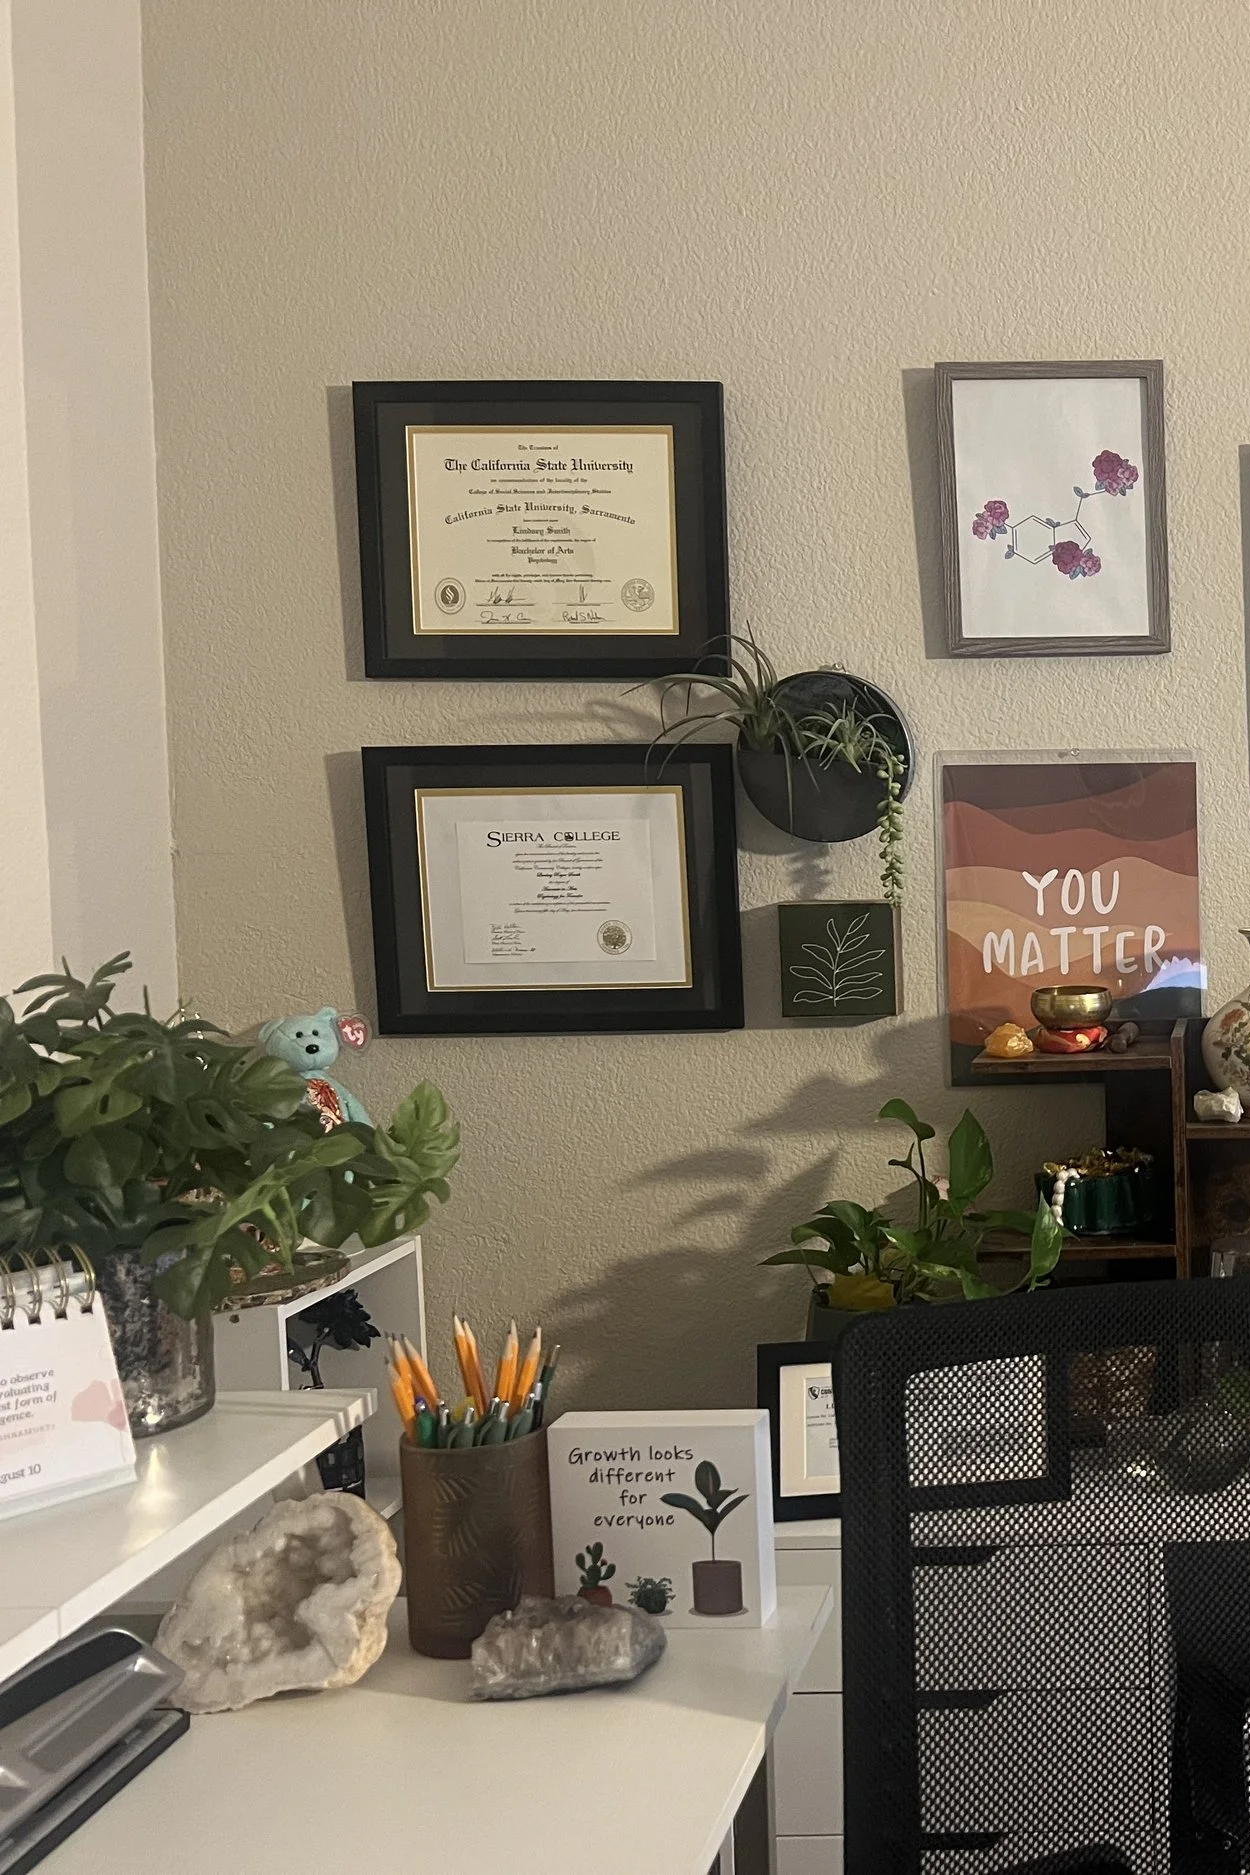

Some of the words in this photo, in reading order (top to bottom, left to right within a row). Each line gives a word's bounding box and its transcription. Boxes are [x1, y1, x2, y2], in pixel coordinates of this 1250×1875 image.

[444, 458, 468, 474] The
[471, 458, 530, 472] California
[534, 458, 568, 474] State
[571, 458, 634, 474] University
[444, 508, 492, 525] California
[496, 504, 521, 514] State
[524, 502, 577, 514] University,
[581, 504, 636, 525] Sacramento
[546, 526, 570, 536] Smith
[511, 546, 545, 556] Bachelor
[548, 546, 555, 554] of
[555, 546, 574, 555] Arts
[486, 831, 544, 848] SIERRA
[553, 831, 620, 842] COLLEGE
[1022, 868, 1120, 916] YOU
[982, 925, 1169, 976] MATTER
[10, 1369, 54, 1384] observe
[14, 1396, 43, 1411] form
[46, 1390, 57, 1403] of
[568, 1446, 641, 1465] Growth
[649, 1444, 694, 1461] looks
[0, 1468, 25, 1485] gust
[28, 1463, 42, 1476] 10
[588, 1467, 676, 1485] different
[619, 1489, 648, 1507] for
[594, 1514, 675, 1530] everyone
